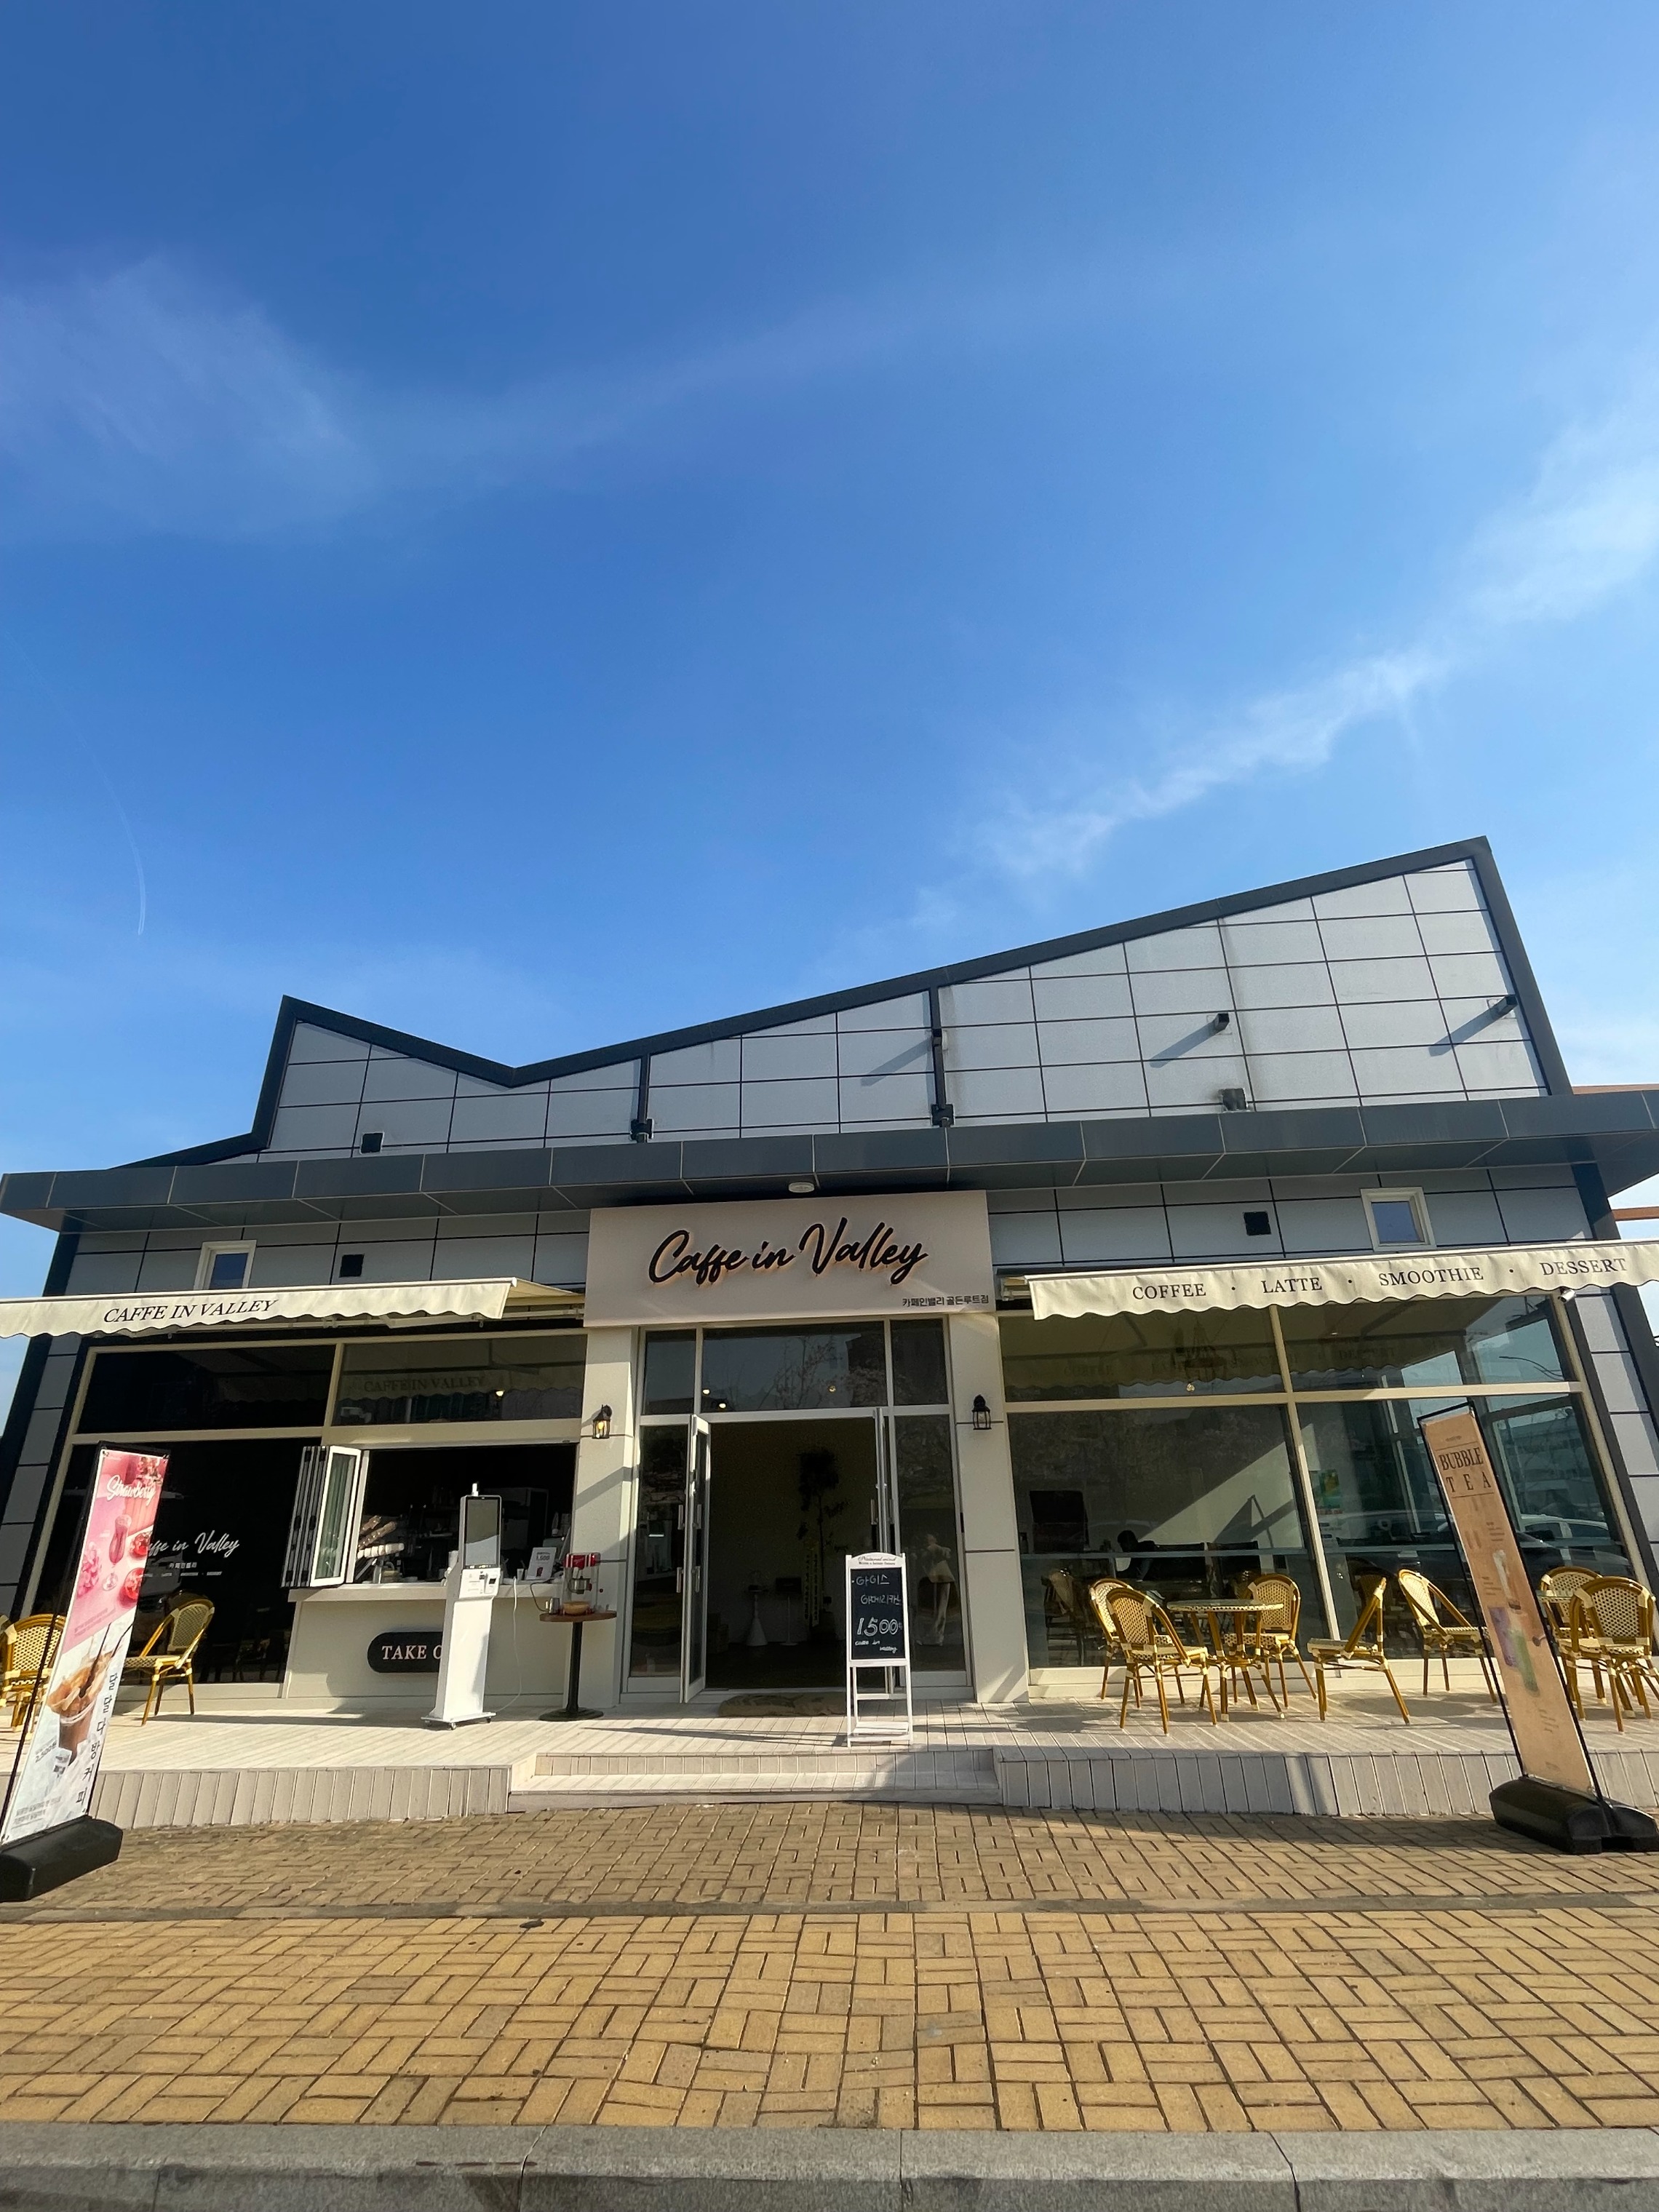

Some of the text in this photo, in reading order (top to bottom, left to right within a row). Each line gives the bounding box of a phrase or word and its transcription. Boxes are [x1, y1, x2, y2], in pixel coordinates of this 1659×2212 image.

[648, 1217, 928, 1286] Caffe in Valley
[1132, 1258, 1626, 1300] COFFEE LATTE SMOOTHIE DESSERT
[103, 1299, 279, 1323] CAFFE IN VALLEY
[902, 1297, 944, 1308] 카페인밸리
[1439, 1447, 1484, 1471] BUBBLE
[172, 1540, 189, 1551] in
[194, 1530, 240, 1559] Valley
[856, 1574, 889, 1586] 아이스
[381, 1645, 427, 1660] TAKE
